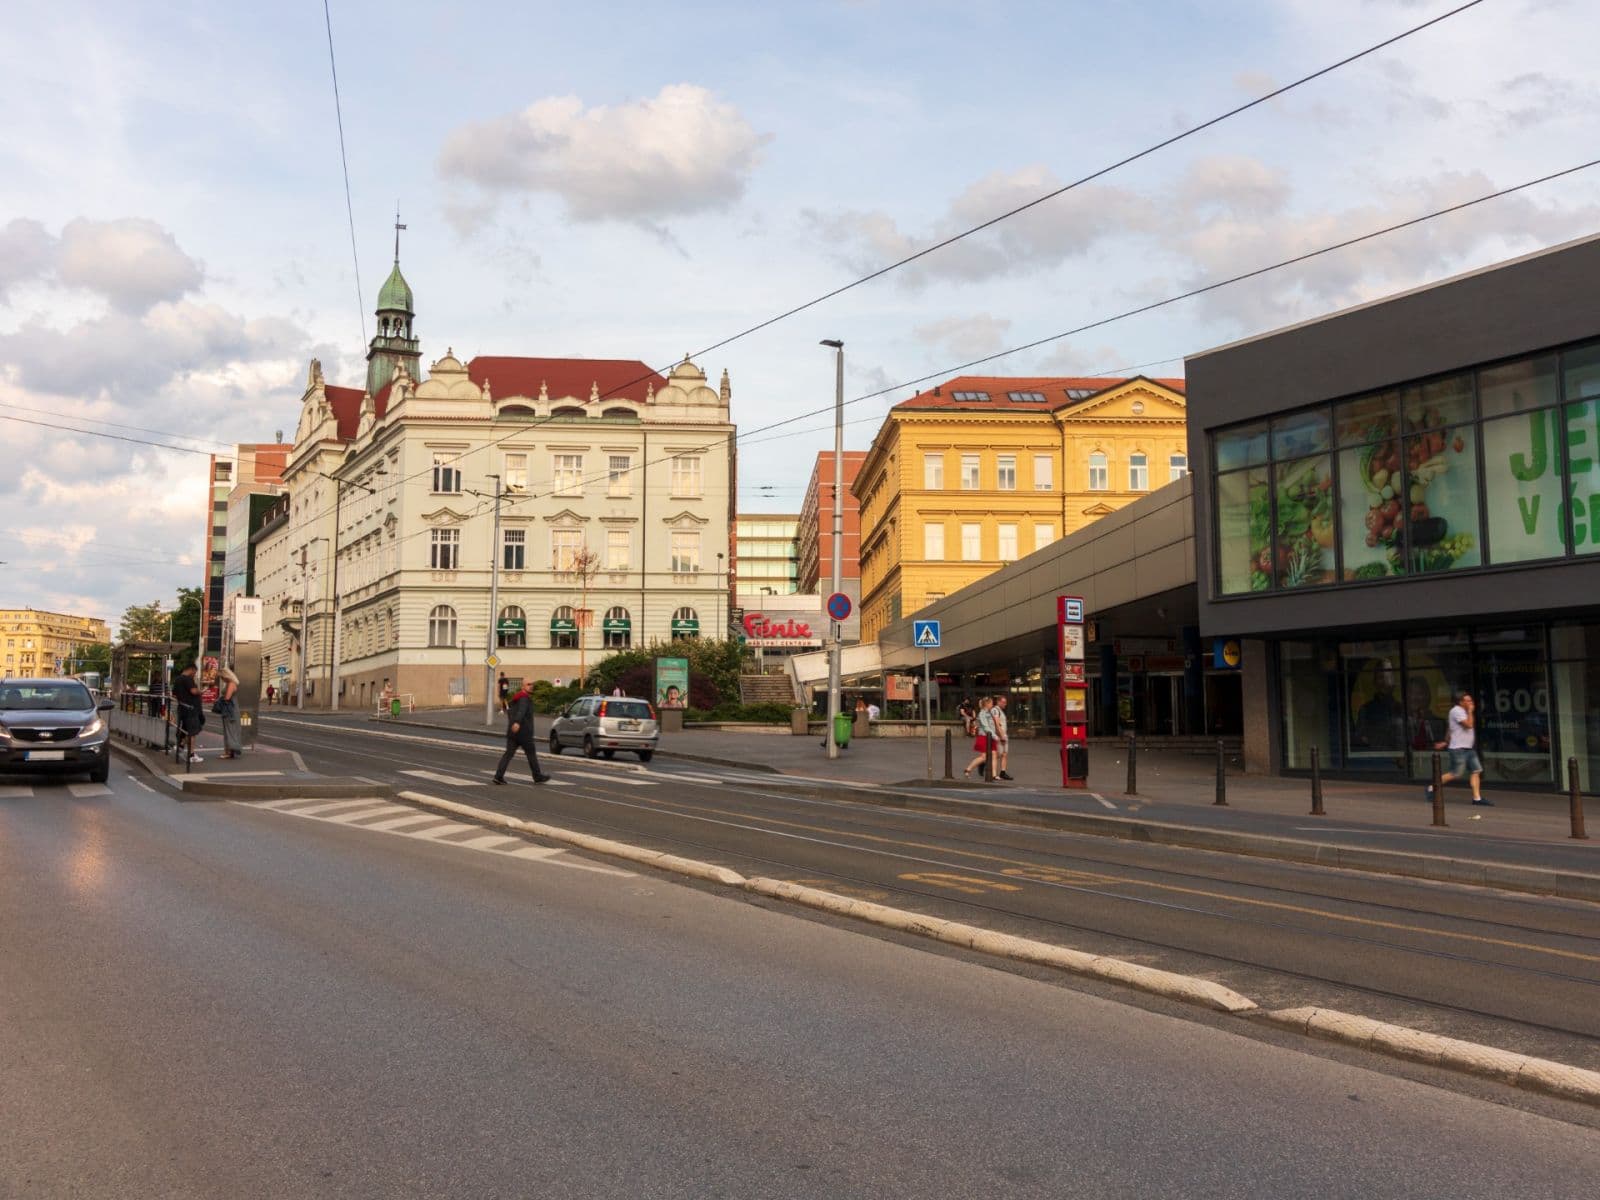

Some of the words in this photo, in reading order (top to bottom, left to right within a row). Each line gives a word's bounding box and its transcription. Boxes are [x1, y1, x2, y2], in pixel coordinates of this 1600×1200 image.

[1509, 402, 1600, 481] JE
[1518, 494, 1541, 535] V
[743, 614, 812, 638] Fénix
